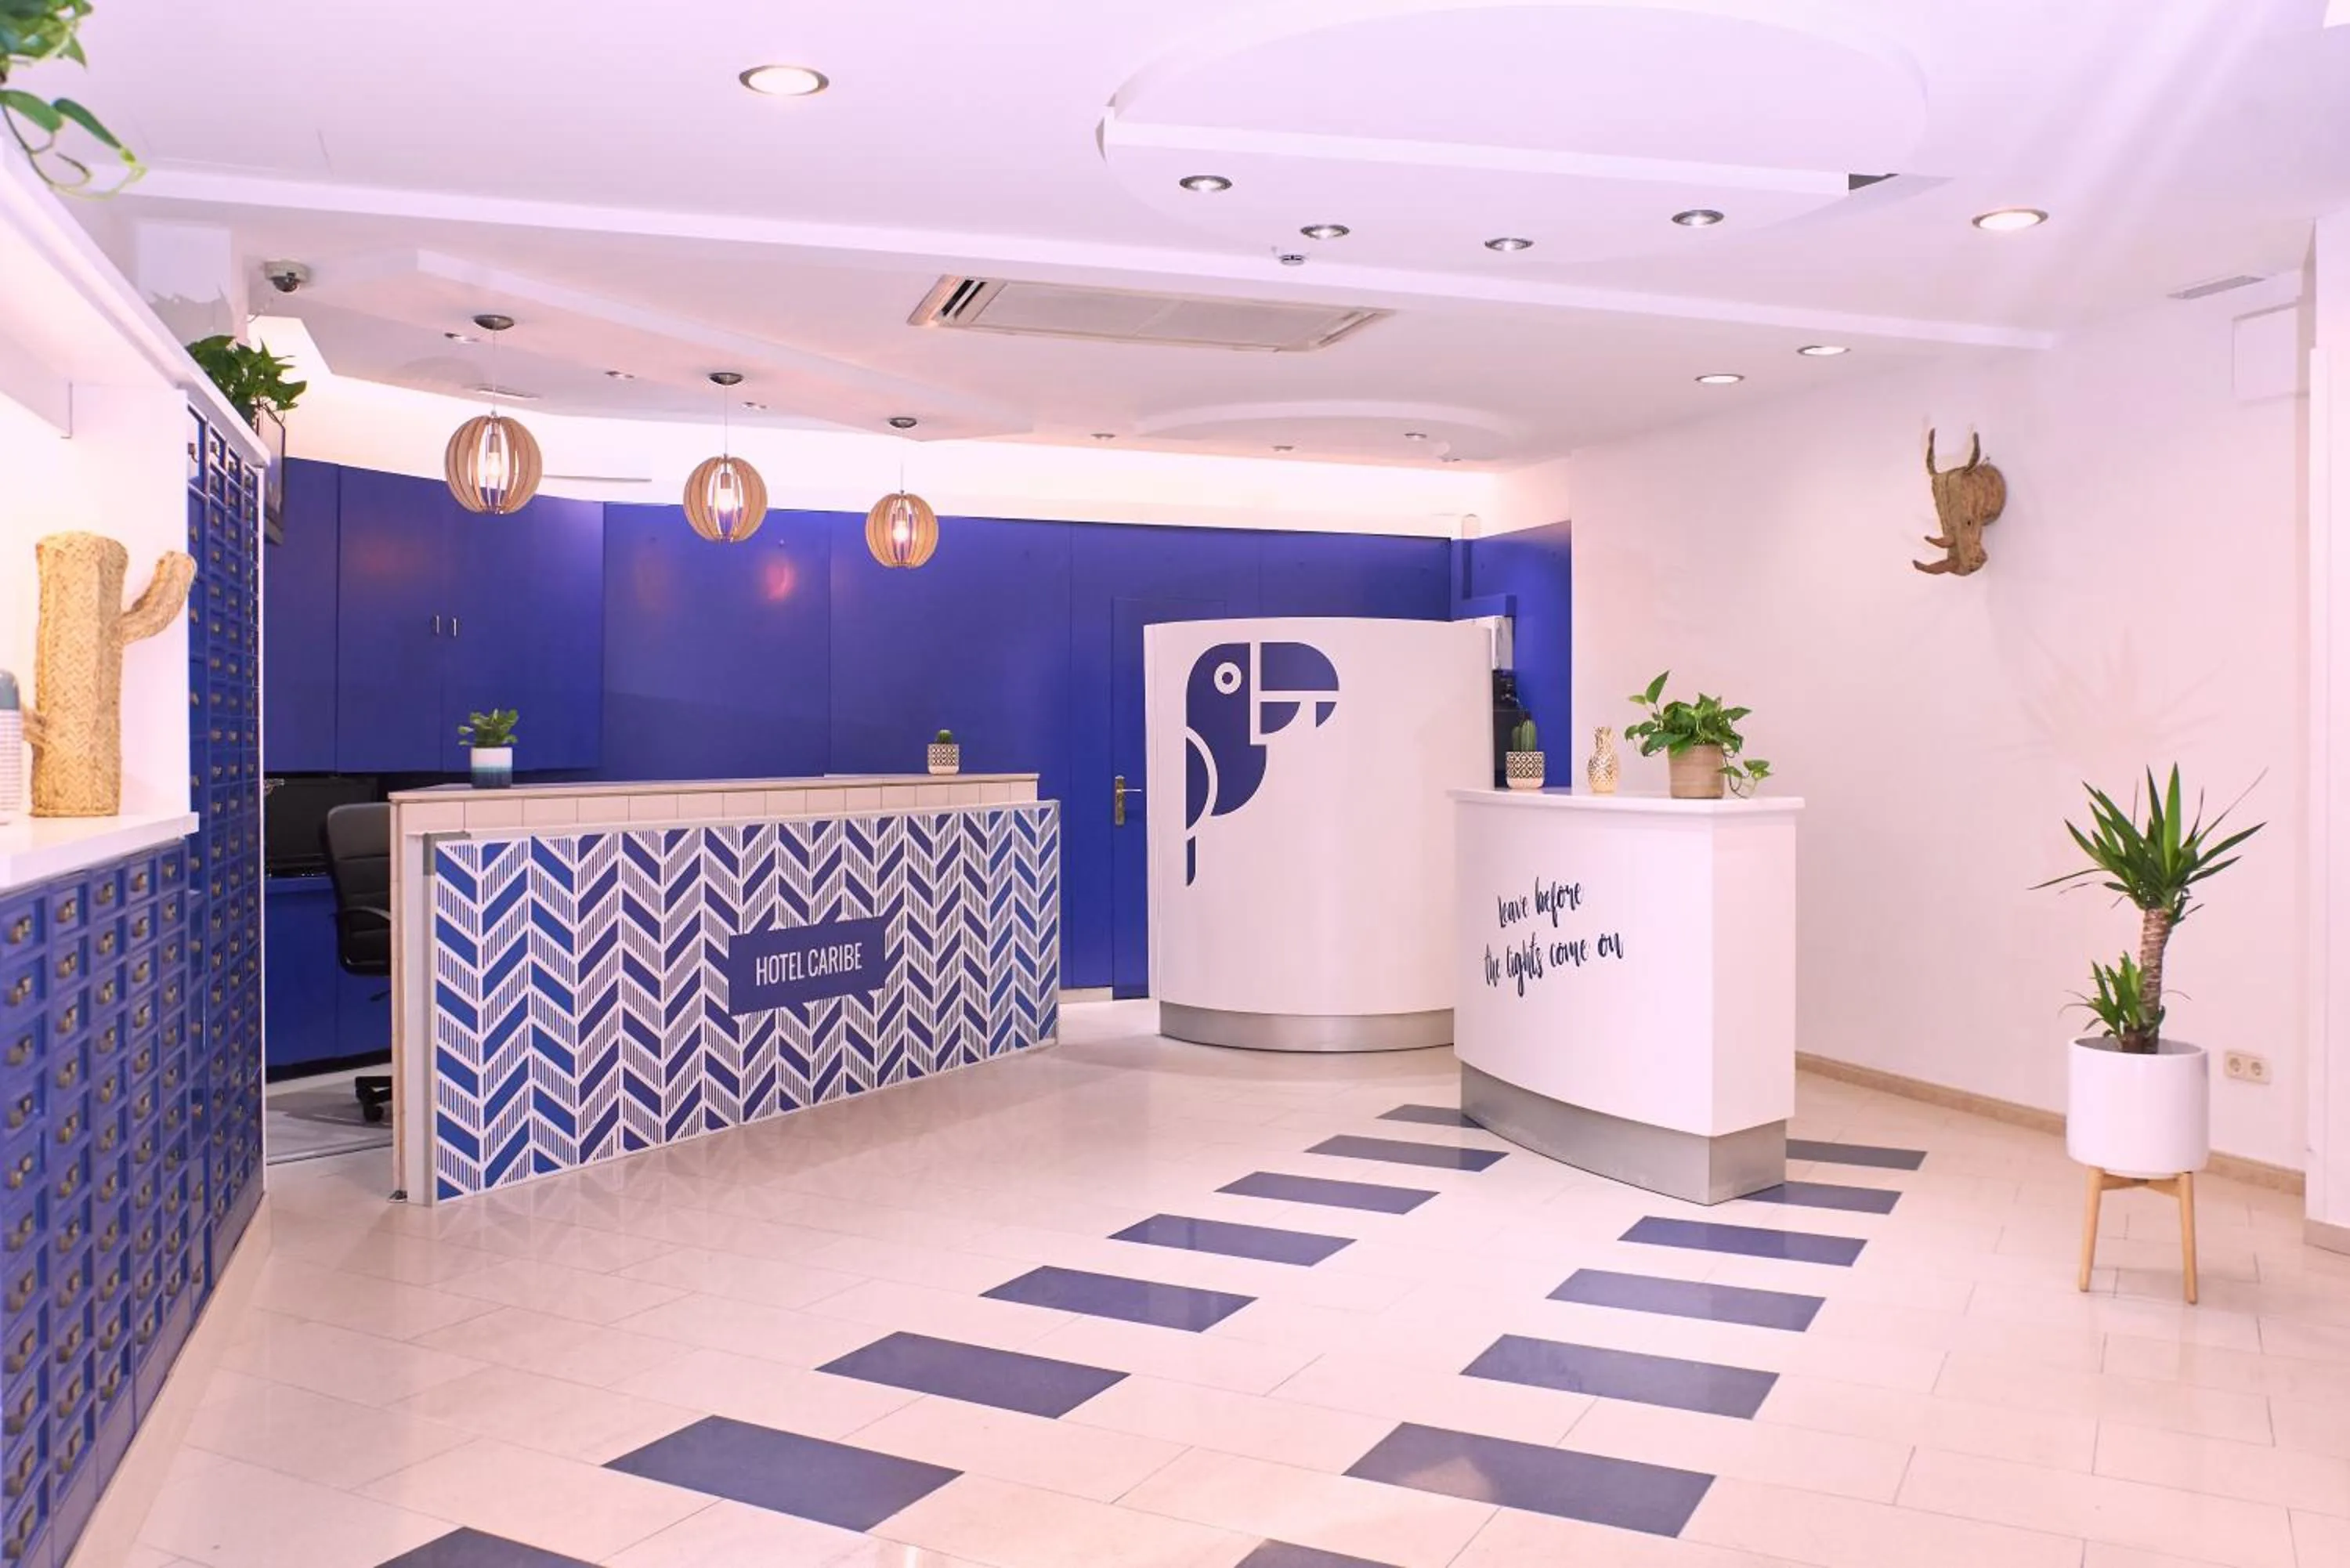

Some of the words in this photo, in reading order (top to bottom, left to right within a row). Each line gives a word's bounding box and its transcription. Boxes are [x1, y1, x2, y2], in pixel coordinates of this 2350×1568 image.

[1497, 894, 1528, 928] leave
[1535, 876, 1582, 928] before
[755, 952, 804, 986] HOTEL
[808, 942, 862, 977] CARIBE
[1484, 942, 1500, 987] the
[1506, 931, 1543, 997] lights
[1549, 939, 1587, 967] come
[1597, 932, 1623, 959] on
